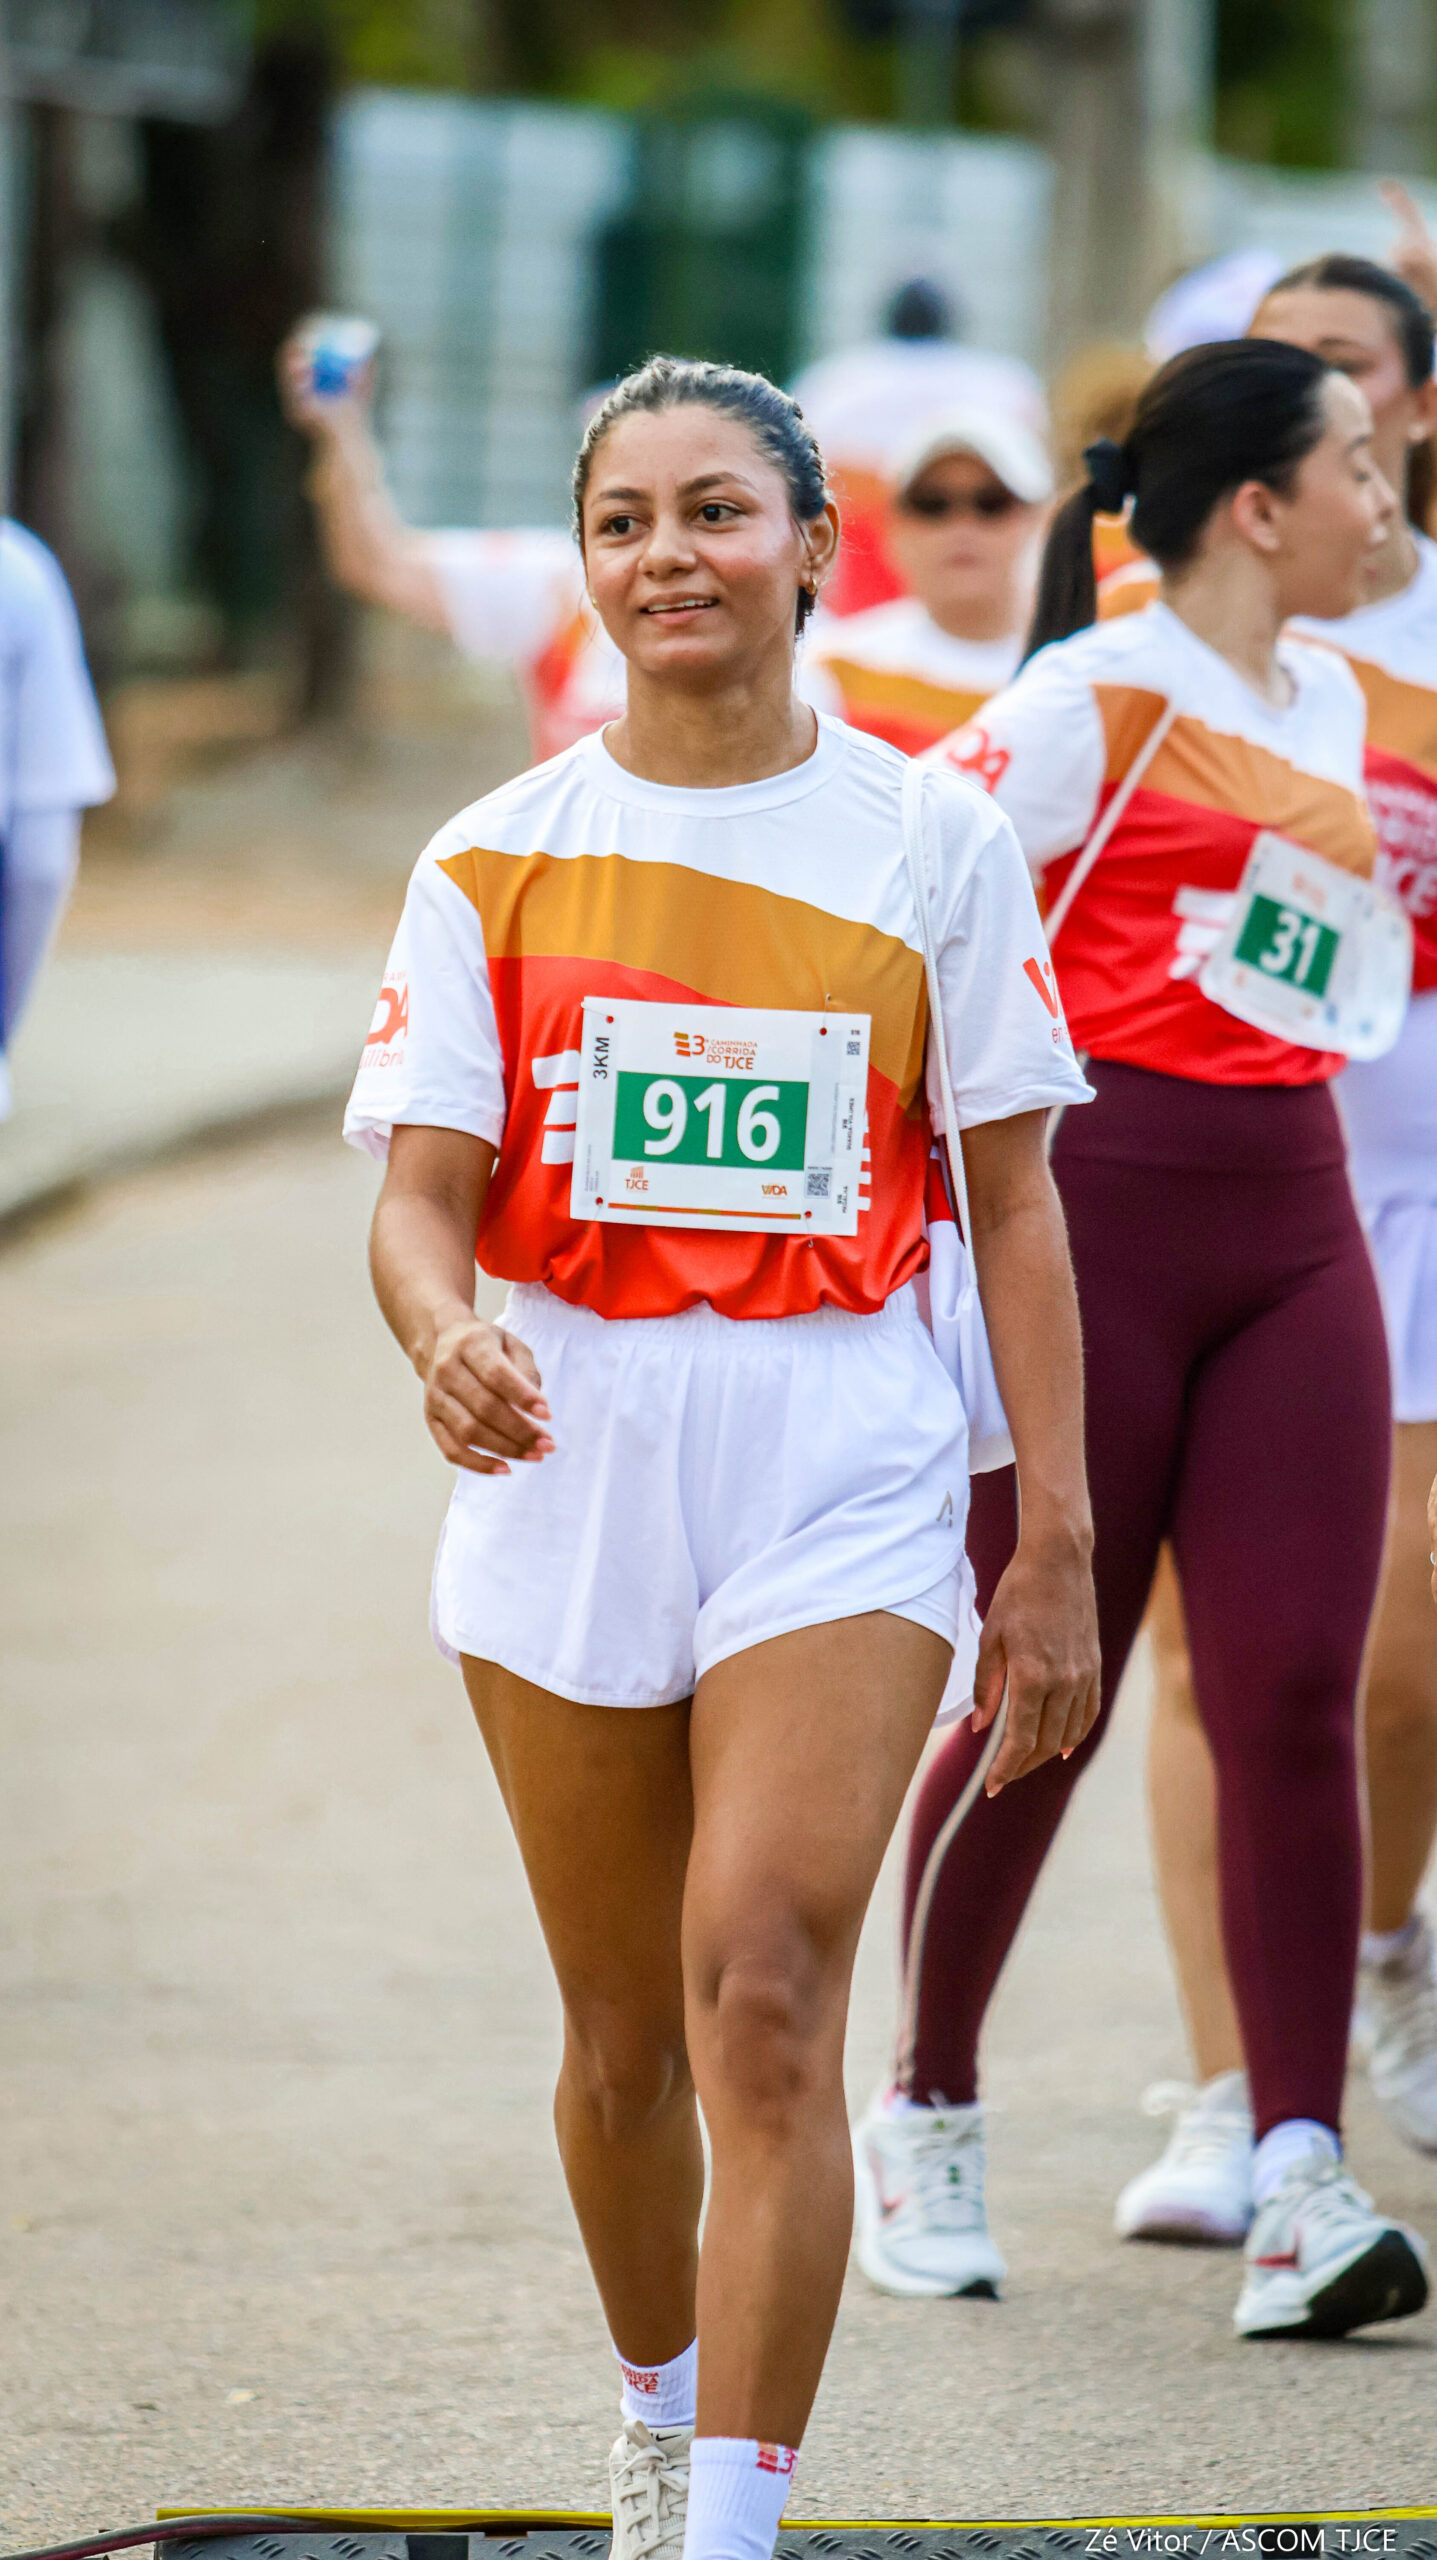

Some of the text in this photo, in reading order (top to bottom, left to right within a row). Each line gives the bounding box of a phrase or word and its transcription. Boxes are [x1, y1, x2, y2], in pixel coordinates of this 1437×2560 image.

[1259, 910, 1321, 983] 31
[593, 1036, 610, 1080] 3KM
[706, 1054, 754, 1070] DO TJCE
[643, 1078, 781, 1162] 916
[625, 1178, 649, 1191] TJCE
